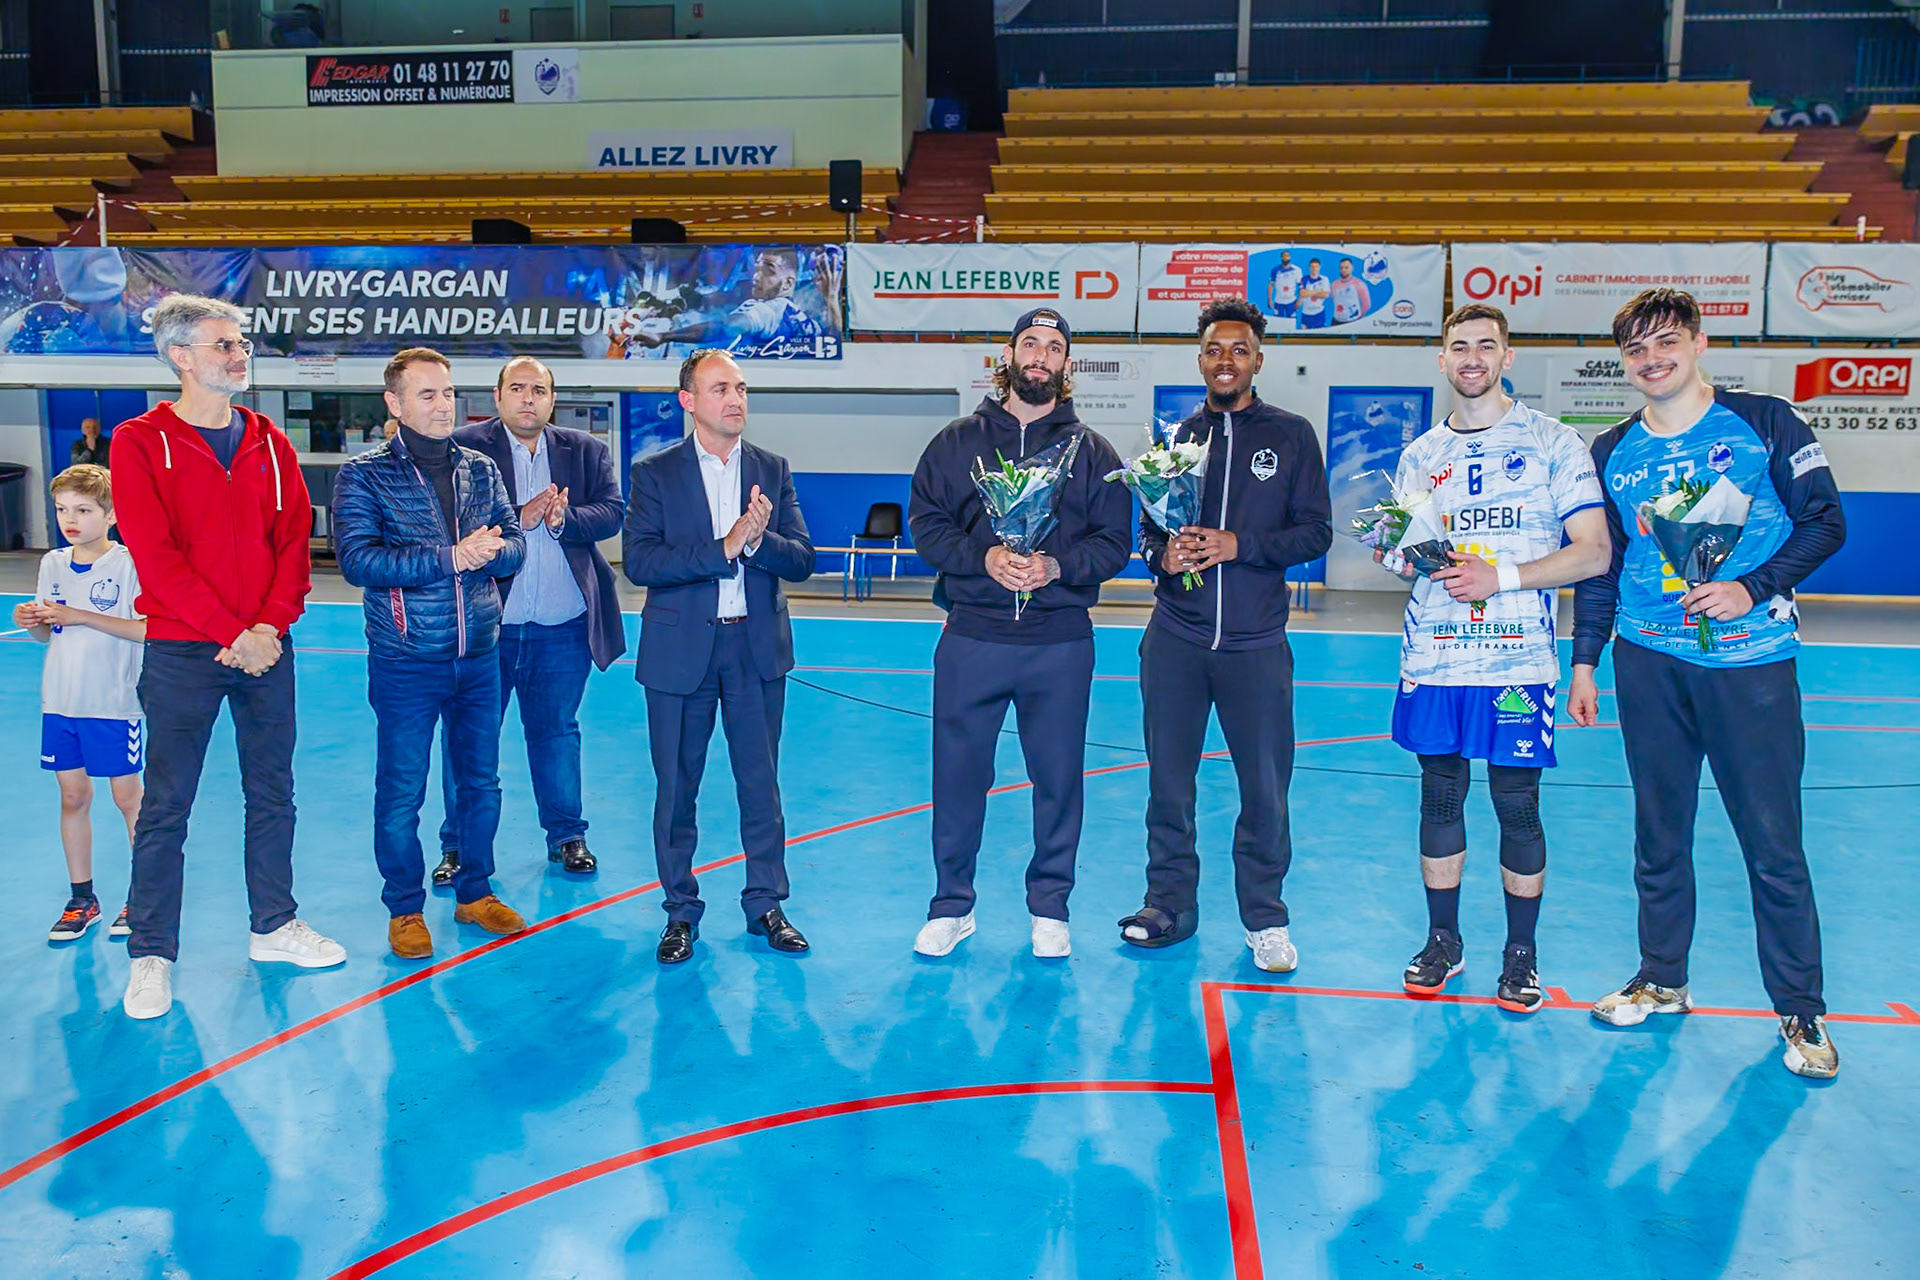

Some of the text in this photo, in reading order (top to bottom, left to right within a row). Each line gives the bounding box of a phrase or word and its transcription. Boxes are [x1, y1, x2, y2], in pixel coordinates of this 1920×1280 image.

[331, 60, 511, 83] EDGAR 01 48 11 27 70
[309, 82, 511, 103] IMPRESSION OFFSET & NUMÉRIQUE
[598, 145, 778, 167] ALLEZ LIVRY
[1175, 252, 1244, 262] votre magasin
[1193, 265, 1243, 275] proche de
[266, 269, 509, 298] LIVRY-GARGAN
[873, 270, 1060, 290] JEAN LEFEBVRE
[1210, 277, 1243, 286] clients
[1463, 265, 1543, 305] Orpi
[1555, 274, 1751, 285] CABINET IMMOBILIER RIVET LENOBLE
[1157, 291, 1168, 299] et
[1170, 290, 1185, 300] qui
[1187, 291, 1211, 299] vous
[306, 307, 365, 335] SES
[374, 307, 642, 336] HANDBALLEURS
[1071, 359, 1120, 377] ptimum
[1578, 369, 1625, 378] REPAIR
[1585, 360, 1620, 369] CASH
[1829, 360, 1908, 388] ORPI
[1827, 406, 1878, 414] LENOBLE
[1808, 417, 1917, 430] 43 30 52 63
[1468, 463, 1483, 496] 6
[1611, 463, 1649, 492] Orpi
[1462, 623, 1524, 635] LEFEBVRE
[1641, 620, 1748, 638] JEAN LEFBVRE
